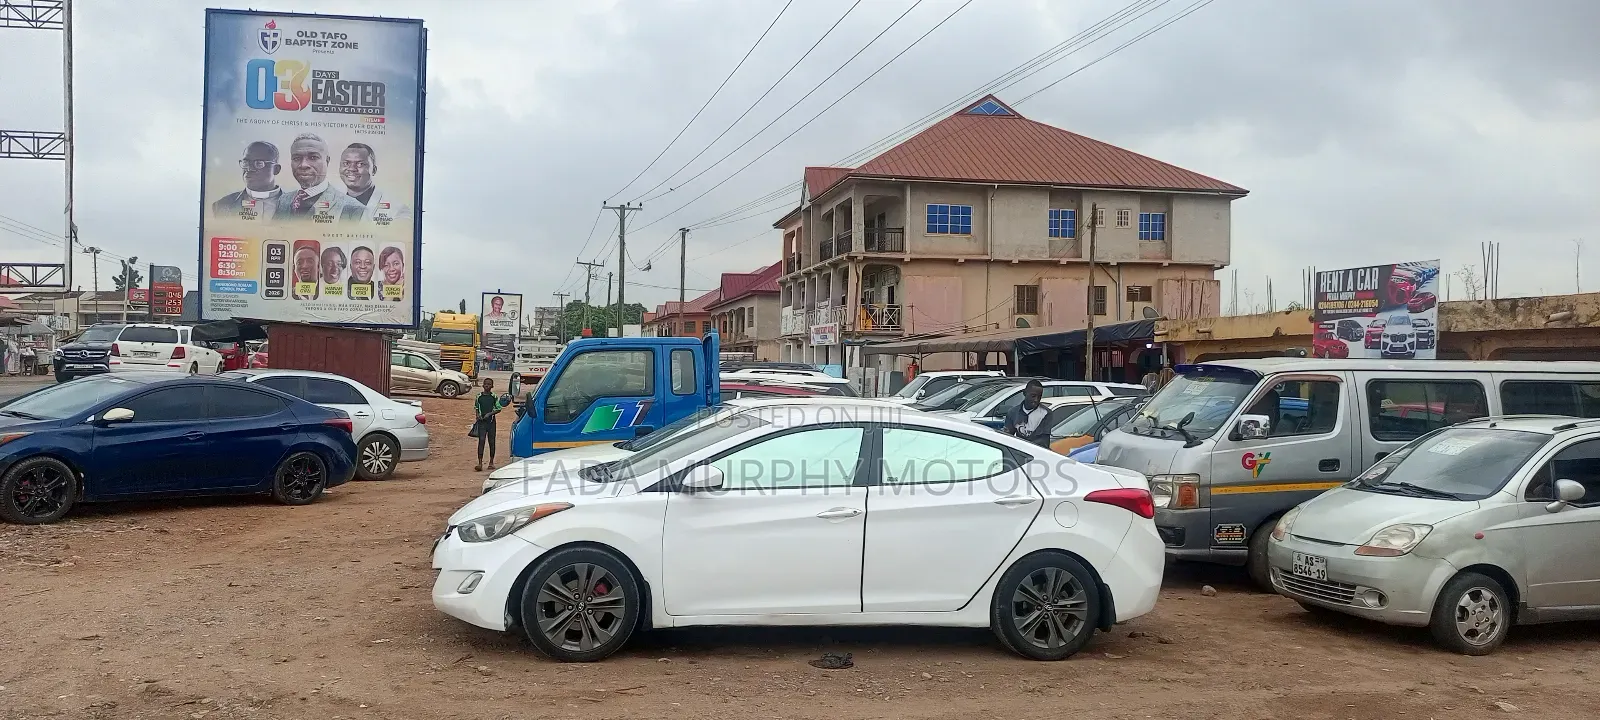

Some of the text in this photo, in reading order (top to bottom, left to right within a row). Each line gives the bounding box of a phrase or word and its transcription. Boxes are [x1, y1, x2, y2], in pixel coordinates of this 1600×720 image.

[296, 30, 348, 40] OLD TAFO
[285, 38, 359, 50] BAPTIST ZONE
[315, 71, 336, 79] DAYS
[246, 59, 312, 111] 03
[312, 79, 386, 107] EASTER
[218, 243, 238, 251] 9:00
[270, 247, 282, 256] 03
[218, 250, 249, 259] 12:30pm
[217, 261, 236, 269] 6:30
[217, 268, 246, 277] 8:30pm
[269, 271, 281, 279] 05
[1320, 267, 1379, 293] RENT A CAR
[1304, 555, 1314, 567] AS
[1293, 563, 1326, 580] 8546-19
